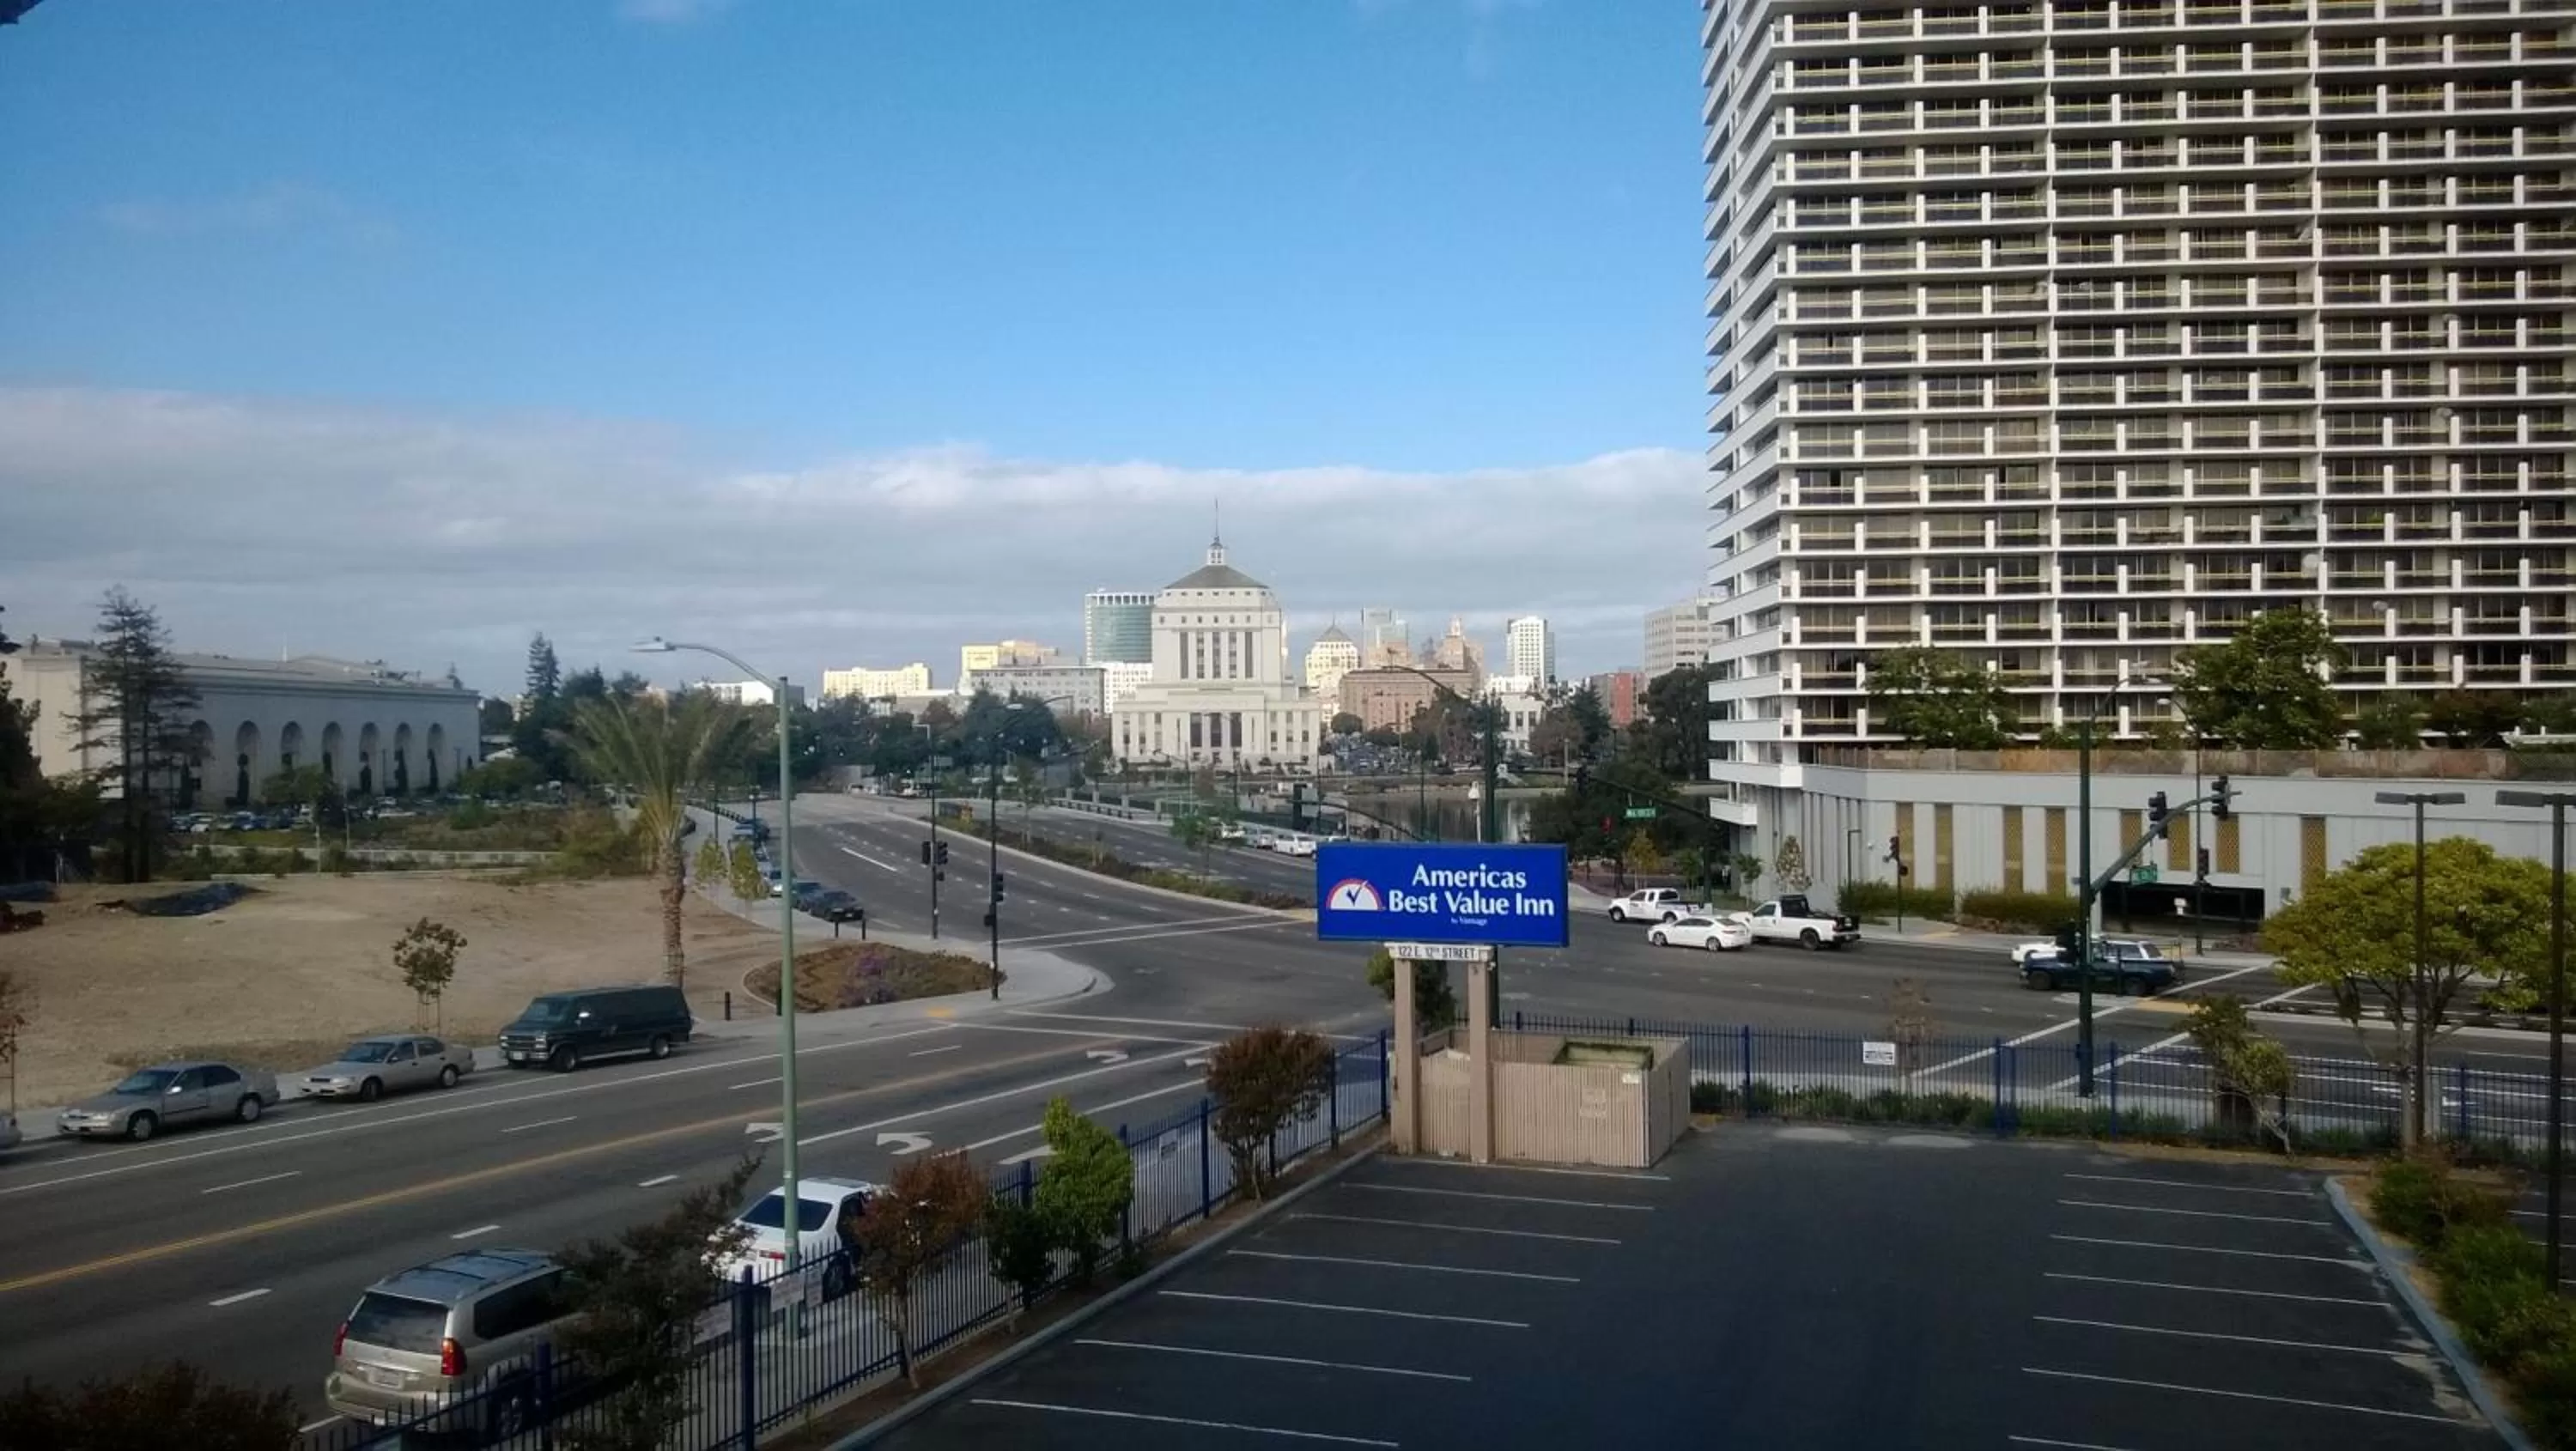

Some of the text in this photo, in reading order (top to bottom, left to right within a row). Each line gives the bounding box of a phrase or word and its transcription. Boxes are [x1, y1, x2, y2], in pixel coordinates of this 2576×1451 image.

[1412, 863, 1527, 889] Americas
[1388, 889, 1555, 917] Best Value Inn
[1442, 947, 1476, 959] STREET
